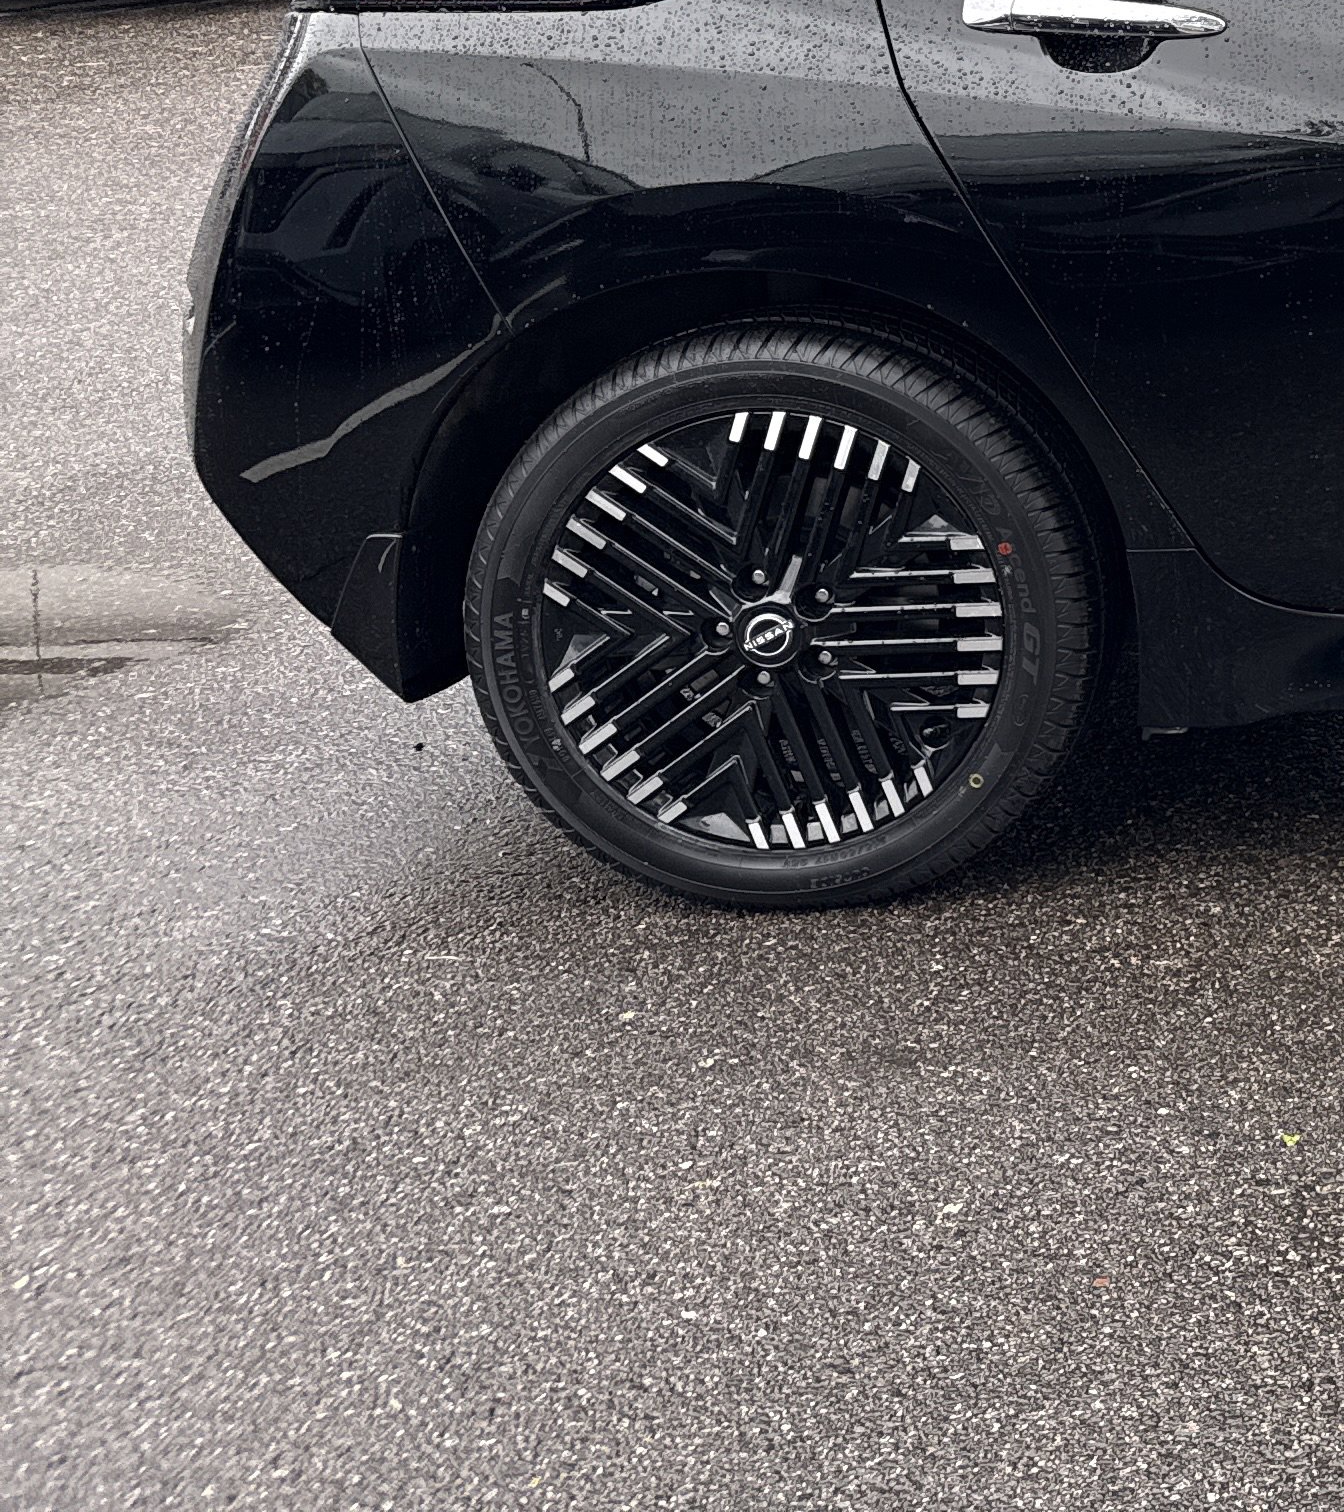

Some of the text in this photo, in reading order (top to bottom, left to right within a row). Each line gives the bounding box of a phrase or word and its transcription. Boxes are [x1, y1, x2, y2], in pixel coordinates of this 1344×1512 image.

[743, 619, 795, 651] NISSAN
[995, 526, 1037, 614] Acend
[1022, 621, 1041, 685] GT
[493, 611, 540, 754] YOKOHAMA
